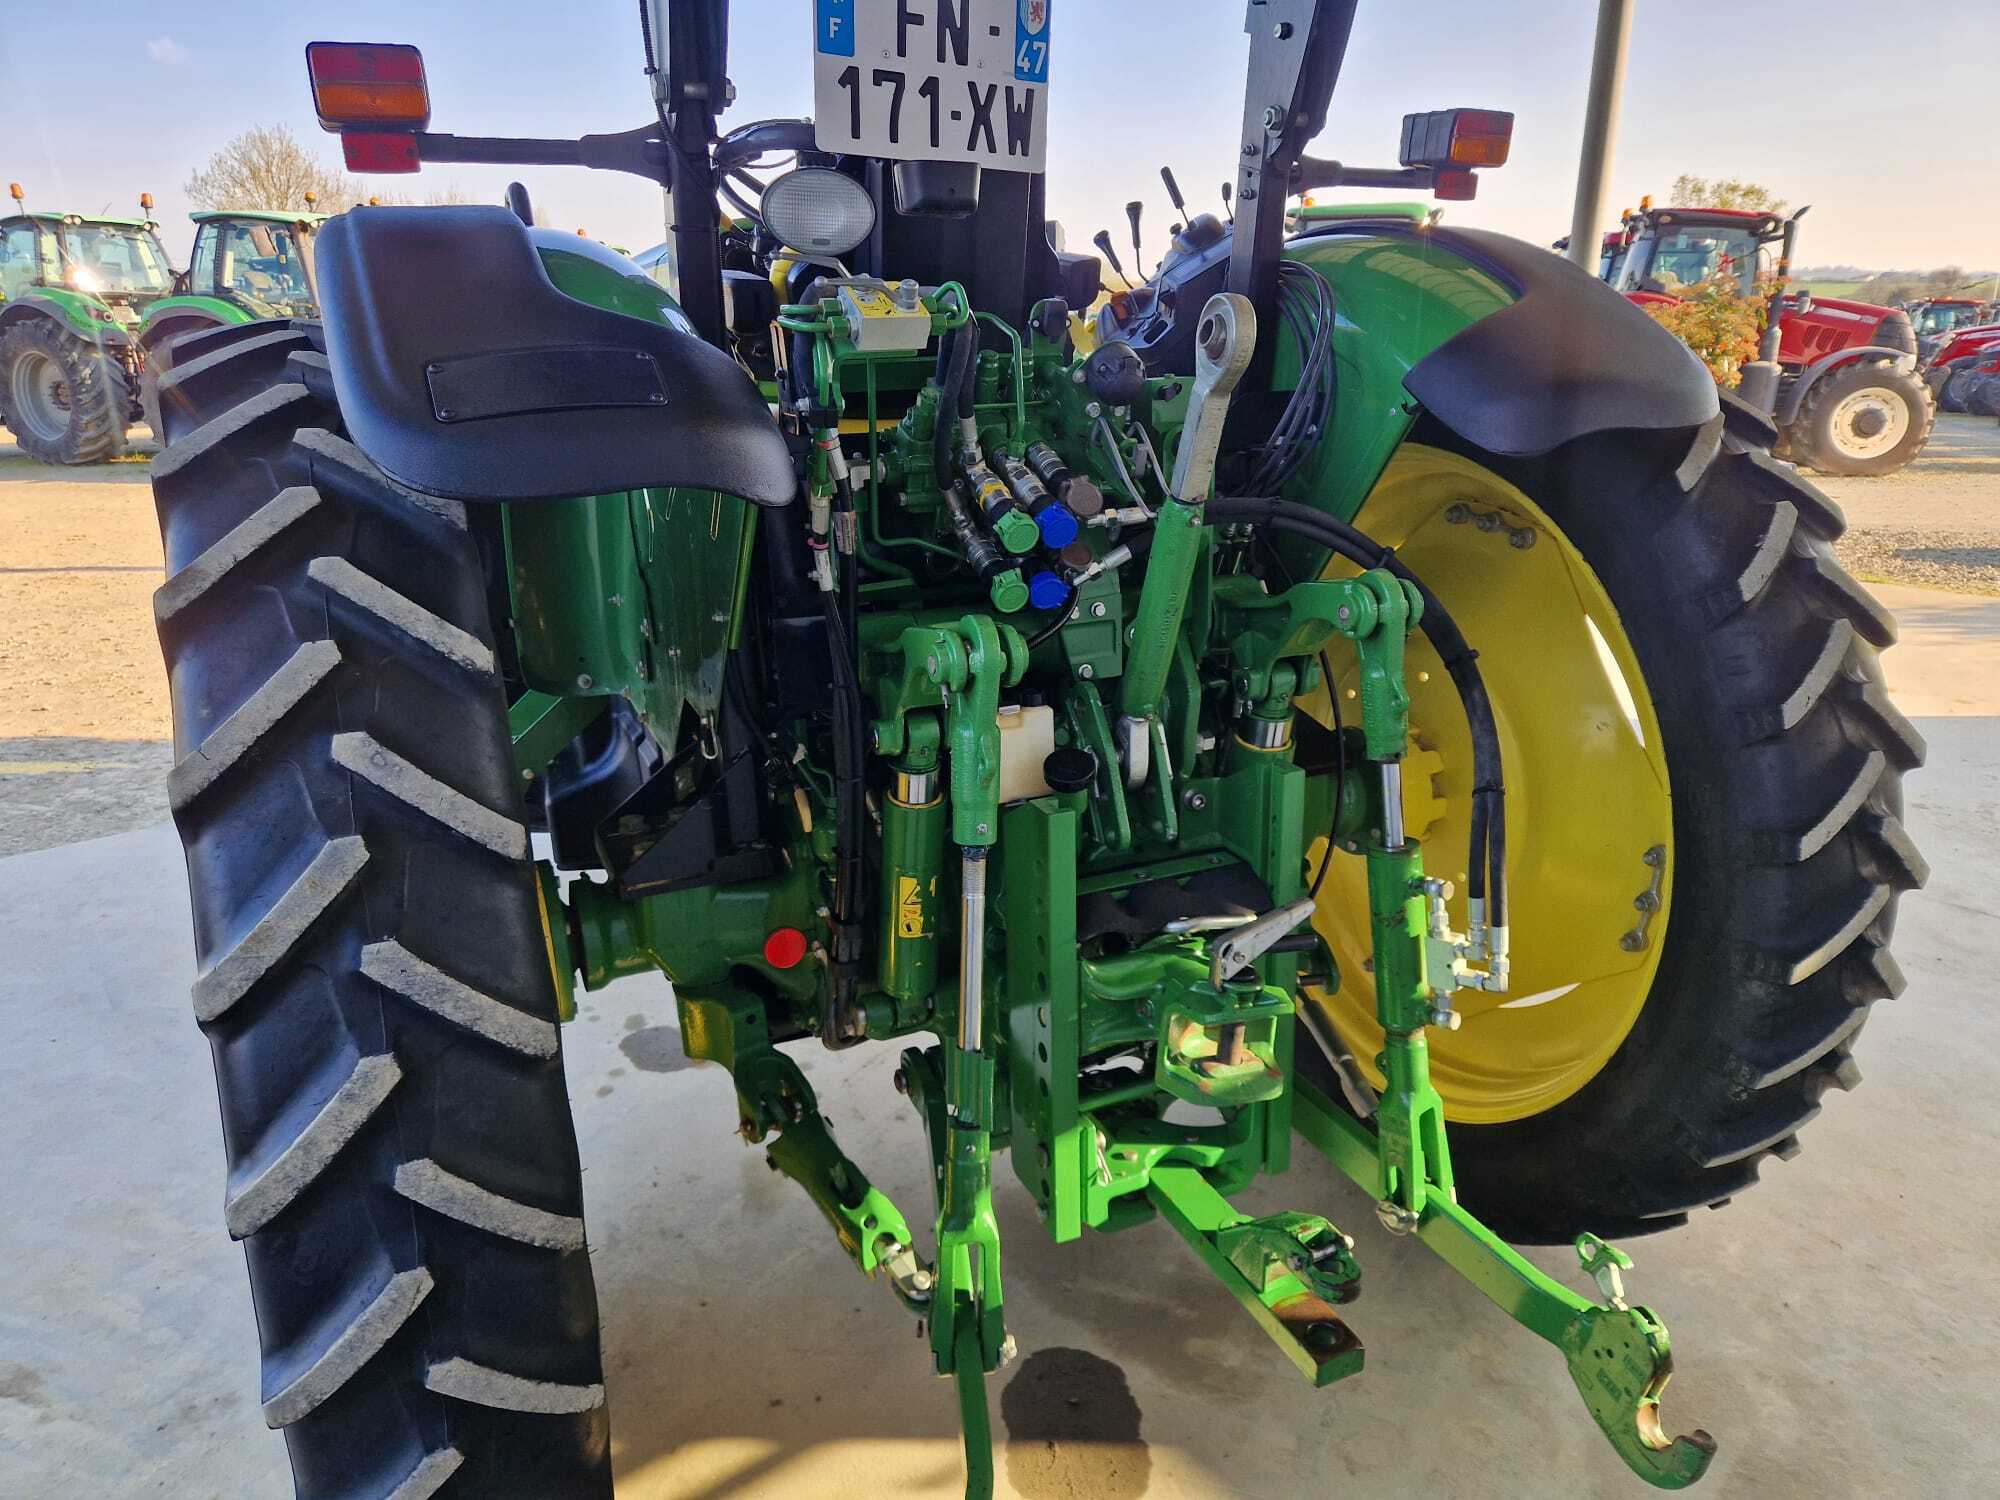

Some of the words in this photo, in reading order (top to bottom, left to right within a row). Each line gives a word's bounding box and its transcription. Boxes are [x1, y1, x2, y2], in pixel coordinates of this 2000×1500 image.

[829, 17, 842, 40] F
[1016, 39, 1047, 74] 47
[838, 66, 1034, 157] 171-XW
